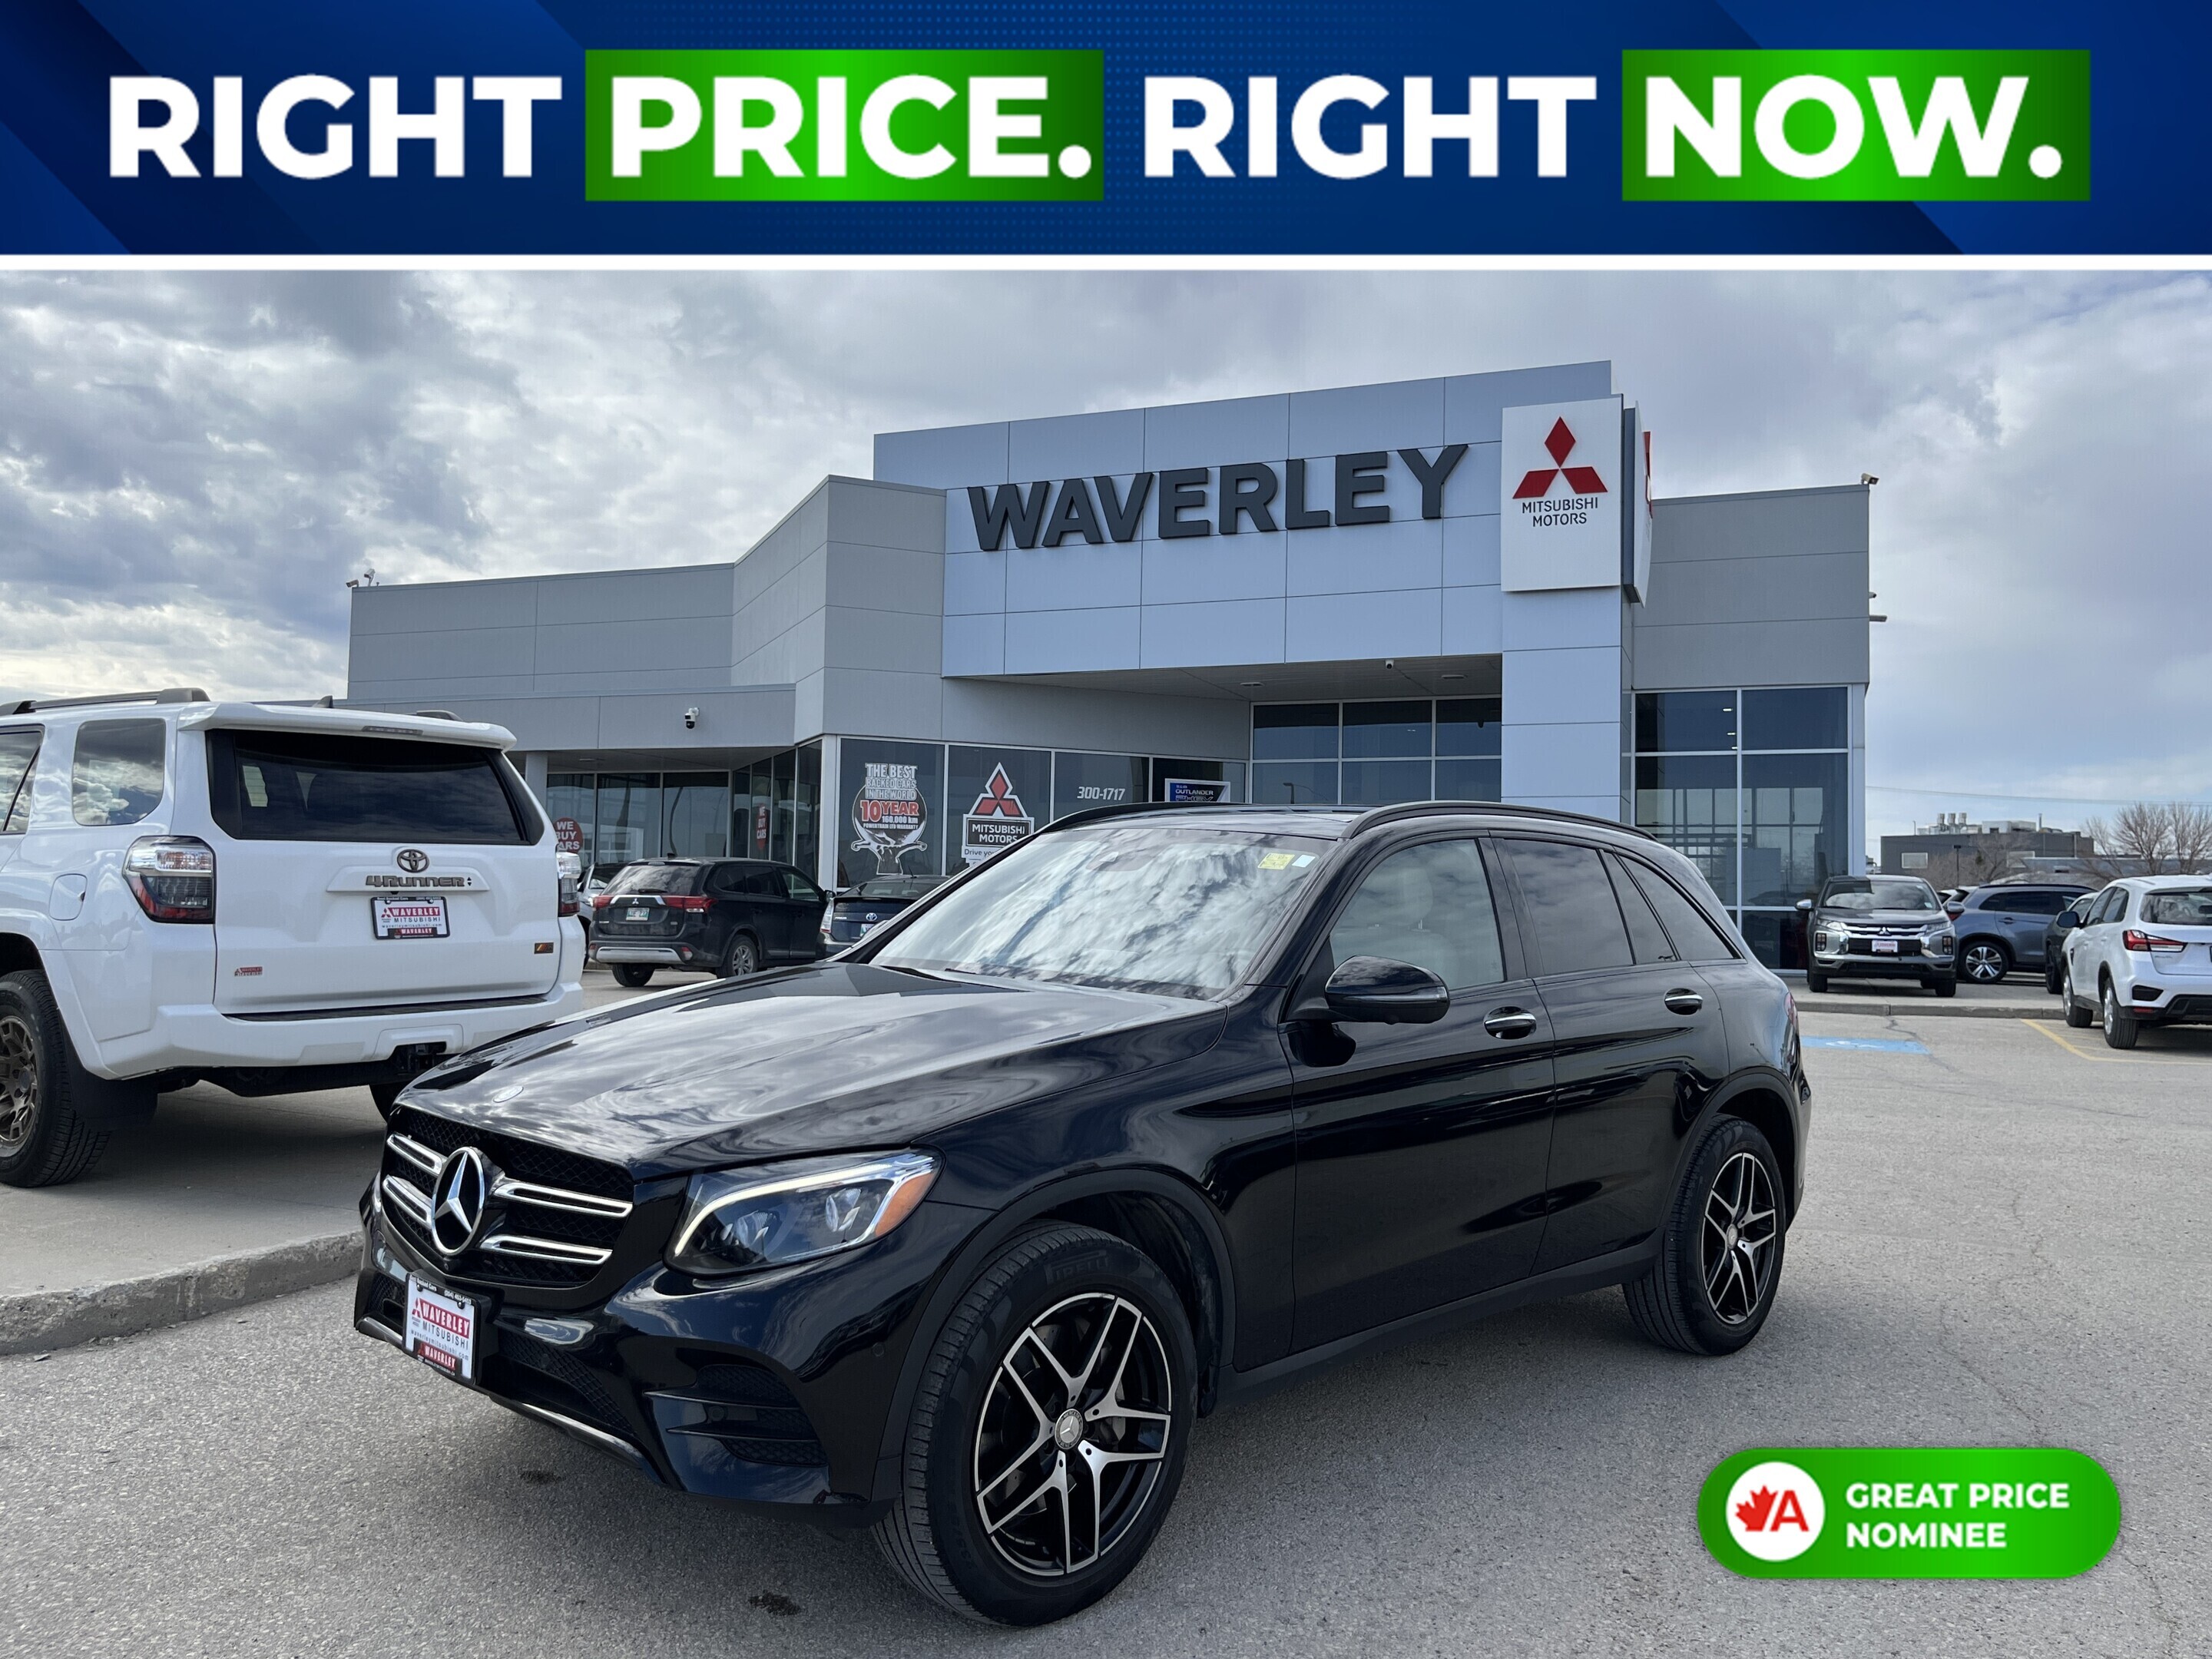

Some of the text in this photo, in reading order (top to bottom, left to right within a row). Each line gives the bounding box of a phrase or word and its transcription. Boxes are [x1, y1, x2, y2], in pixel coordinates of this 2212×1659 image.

[967, 444, 1469, 551] WAVERLEY
[1522, 497, 1598, 514] MITSUBISHI
[1533, 512, 1588, 527] MOTORS
[866, 763, 918, 779] THE BEST
[866, 778, 916, 789] BACKED CARS
[866, 789, 916, 800] IN THE WORLD
[1077, 786, 1126, 800] 300-1717
[860, 800, 919, 823] 10 YEAR
[557, 821, 574, 830] WE
[908, 816, 918, 824] km
[972, 824, 1025, 834] MITSUBISHI
[558, 841, 580, 850] ARS
[979, 834, 1018, 843] MOTORS
[392, 908, 439, 916] WAVERLEY
[422, 1302, 469, 1336] WAVERLEY
[422, 1320, 469, 1349] MITSUBISHI
[425, 1346, 455, 1368] WAVERLEY
